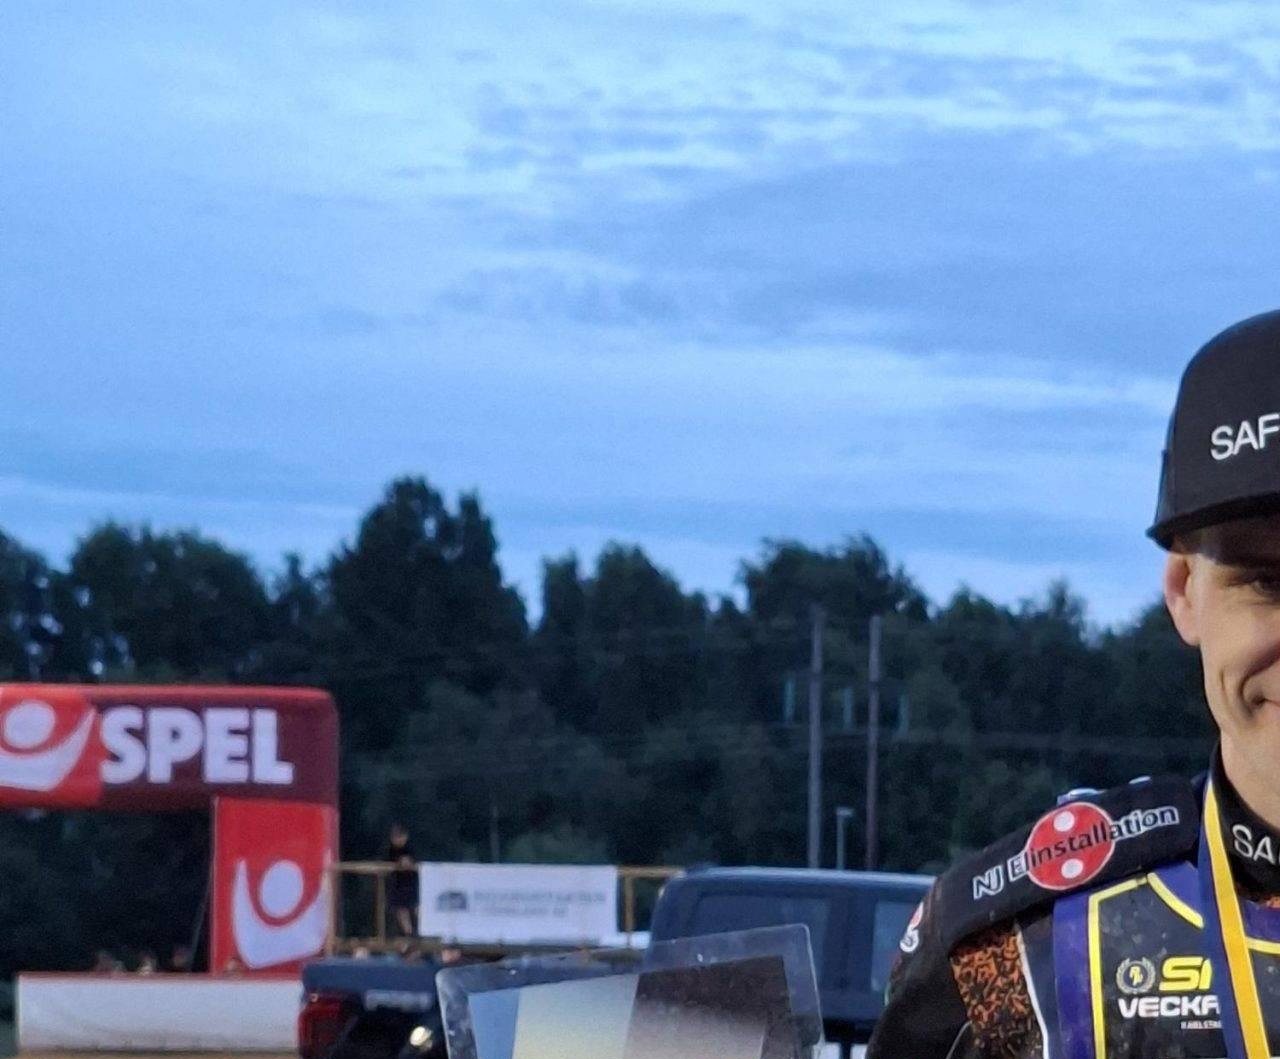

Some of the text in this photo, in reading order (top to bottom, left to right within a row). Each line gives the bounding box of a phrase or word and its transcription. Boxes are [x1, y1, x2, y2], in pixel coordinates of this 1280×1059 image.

[100, 707, 294, 785] SPEL
[973, 864, 1005, 899] NJ
[1118, 995, 1220, 1018] VECKA
